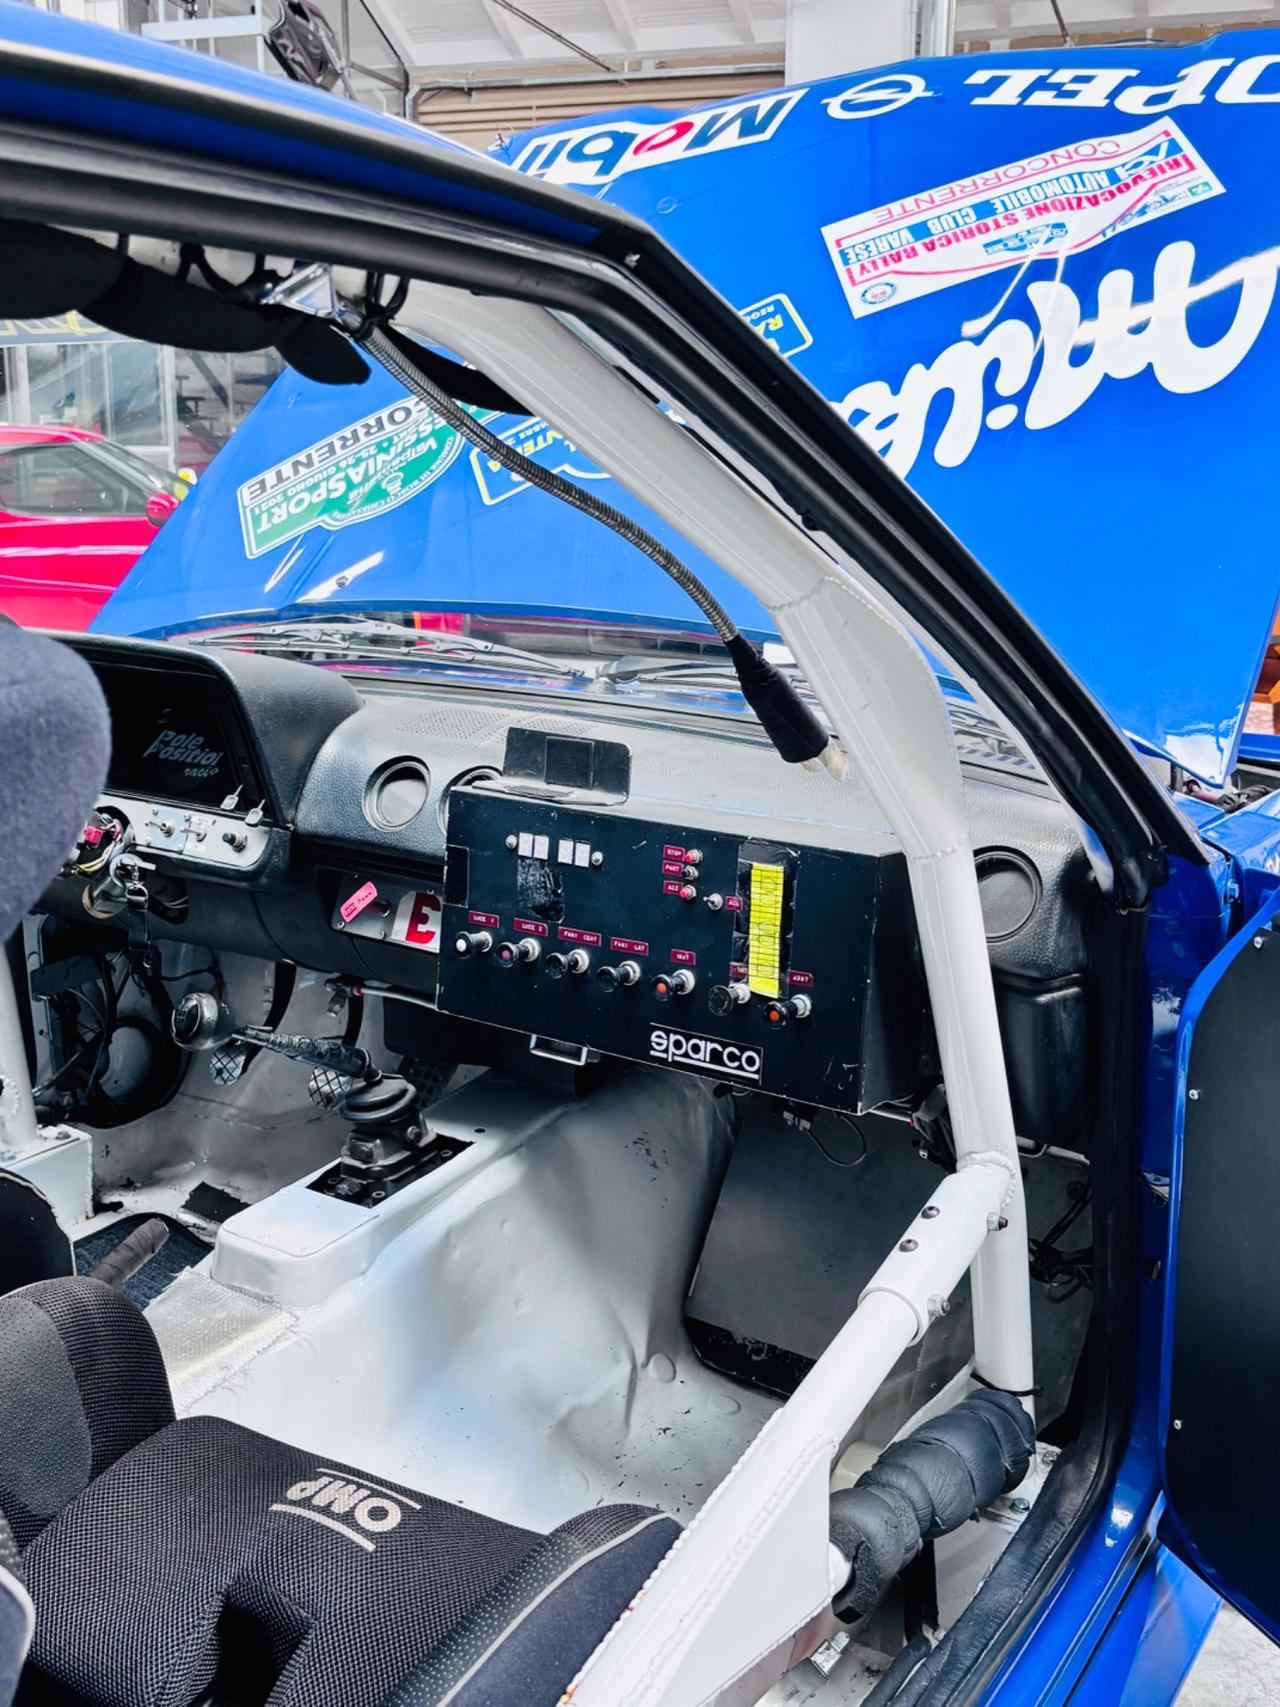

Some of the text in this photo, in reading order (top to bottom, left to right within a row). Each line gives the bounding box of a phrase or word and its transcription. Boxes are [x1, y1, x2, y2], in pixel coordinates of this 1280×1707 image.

[966, 54, 1280, 115] OPEL
[518, 97, 793, 178] Mobil
[874, 140, 1120, 223] CONCORRENTE
[991, 170, 1111, 214] AUTOMOBILE
[1021, 158, 1184, 221] RIEVOCAZIONE
[922, 212, 1020, 252] STORICA
[927, 207, 977, 235] CLUB
[844, 228, 915, 264] VARESE
[858, 246, 920, 277] RALLY
[287, 466, 337, 497] GIUGNO
[253, 493, 286, 515] 2021
[650, 1030, 760, 1074] sparco
[286, 1475, 402, 1533] OMP
